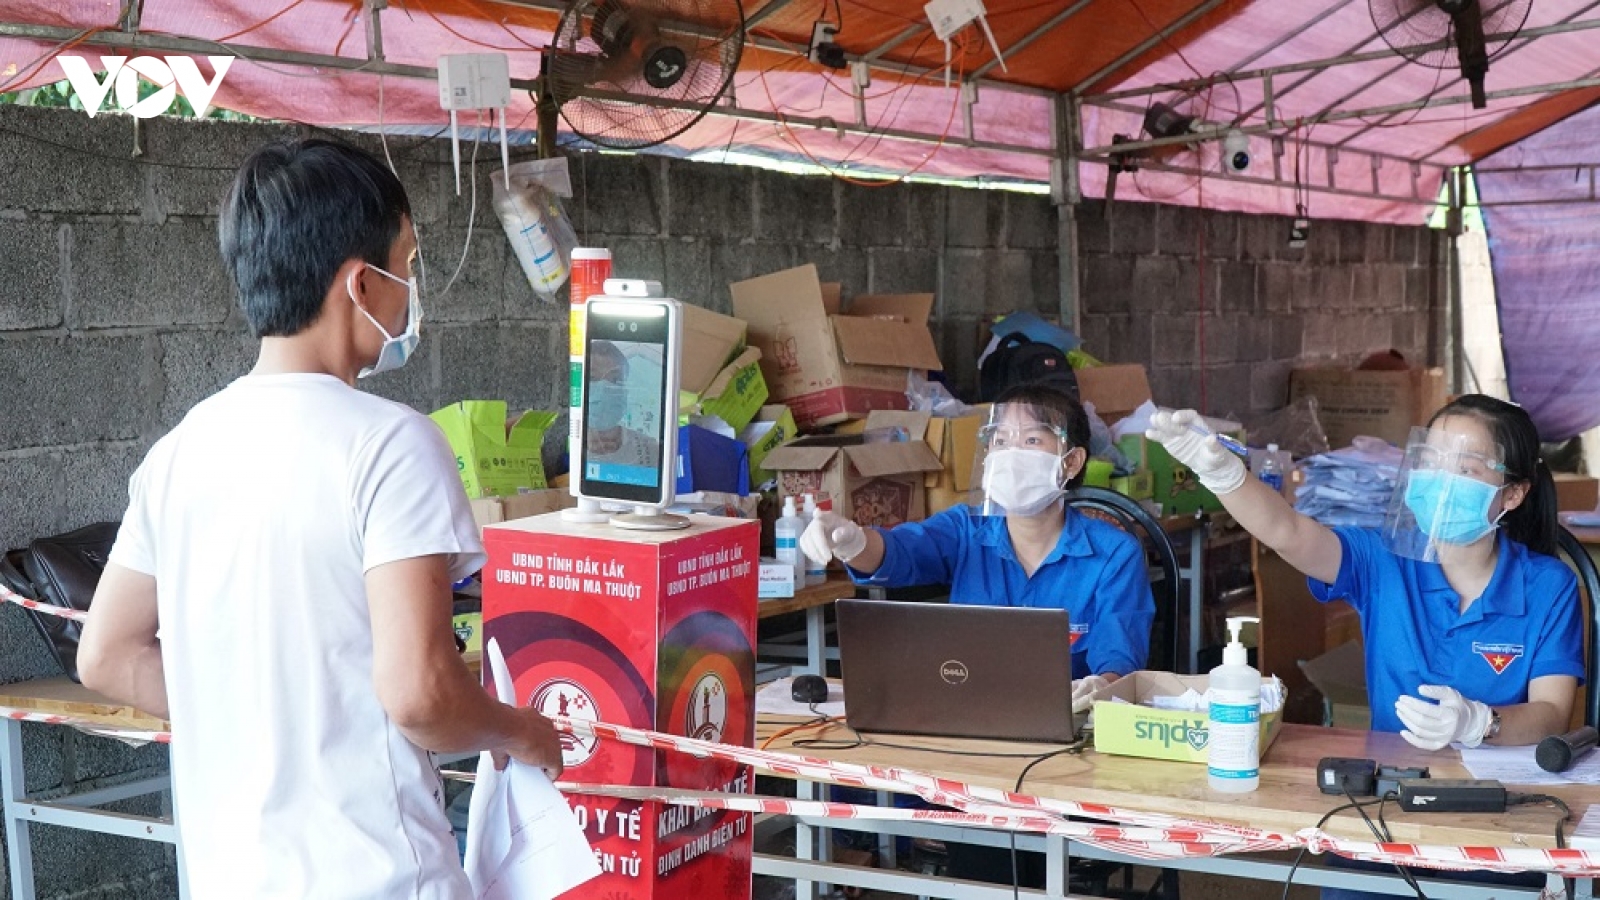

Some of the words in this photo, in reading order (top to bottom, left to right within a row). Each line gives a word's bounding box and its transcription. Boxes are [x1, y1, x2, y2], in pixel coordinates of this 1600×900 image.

[512, 552, 543, 569] UBND
[547, 552, 573, 572] TỈNH
[575, 556, 599, 576] ĐẮK
[602, 559, 625, 579] LẮK
[677, 556, 697, 575] UBND
[699, 551, 714, 569] TỈNH
[496, 569, 527, 586] UBND
[530, 573, 545, 588] TP.
[548, 574, 580, 592] BUÔN
[583, 579, 602, 595] MA
[605, 581, 642, 602] THUỘT
[666, 578, 687, 597] UBND
[719, 566, 731, 581] MA
[943, 668, 966, 676] DELL
[1134, 719, 1188, 748] plus
[595, 808, 609, 834] Y
[616, 806, 643, 841] TẾ
[658, 803, 689, 839] KHAI
[620, 850, 643, 877] TỬ
[658, 847, 682, 876] ĐỊNH
[684, 834, 710, 861] DANH
[711, 821, 733, 848] ĐIỆN
